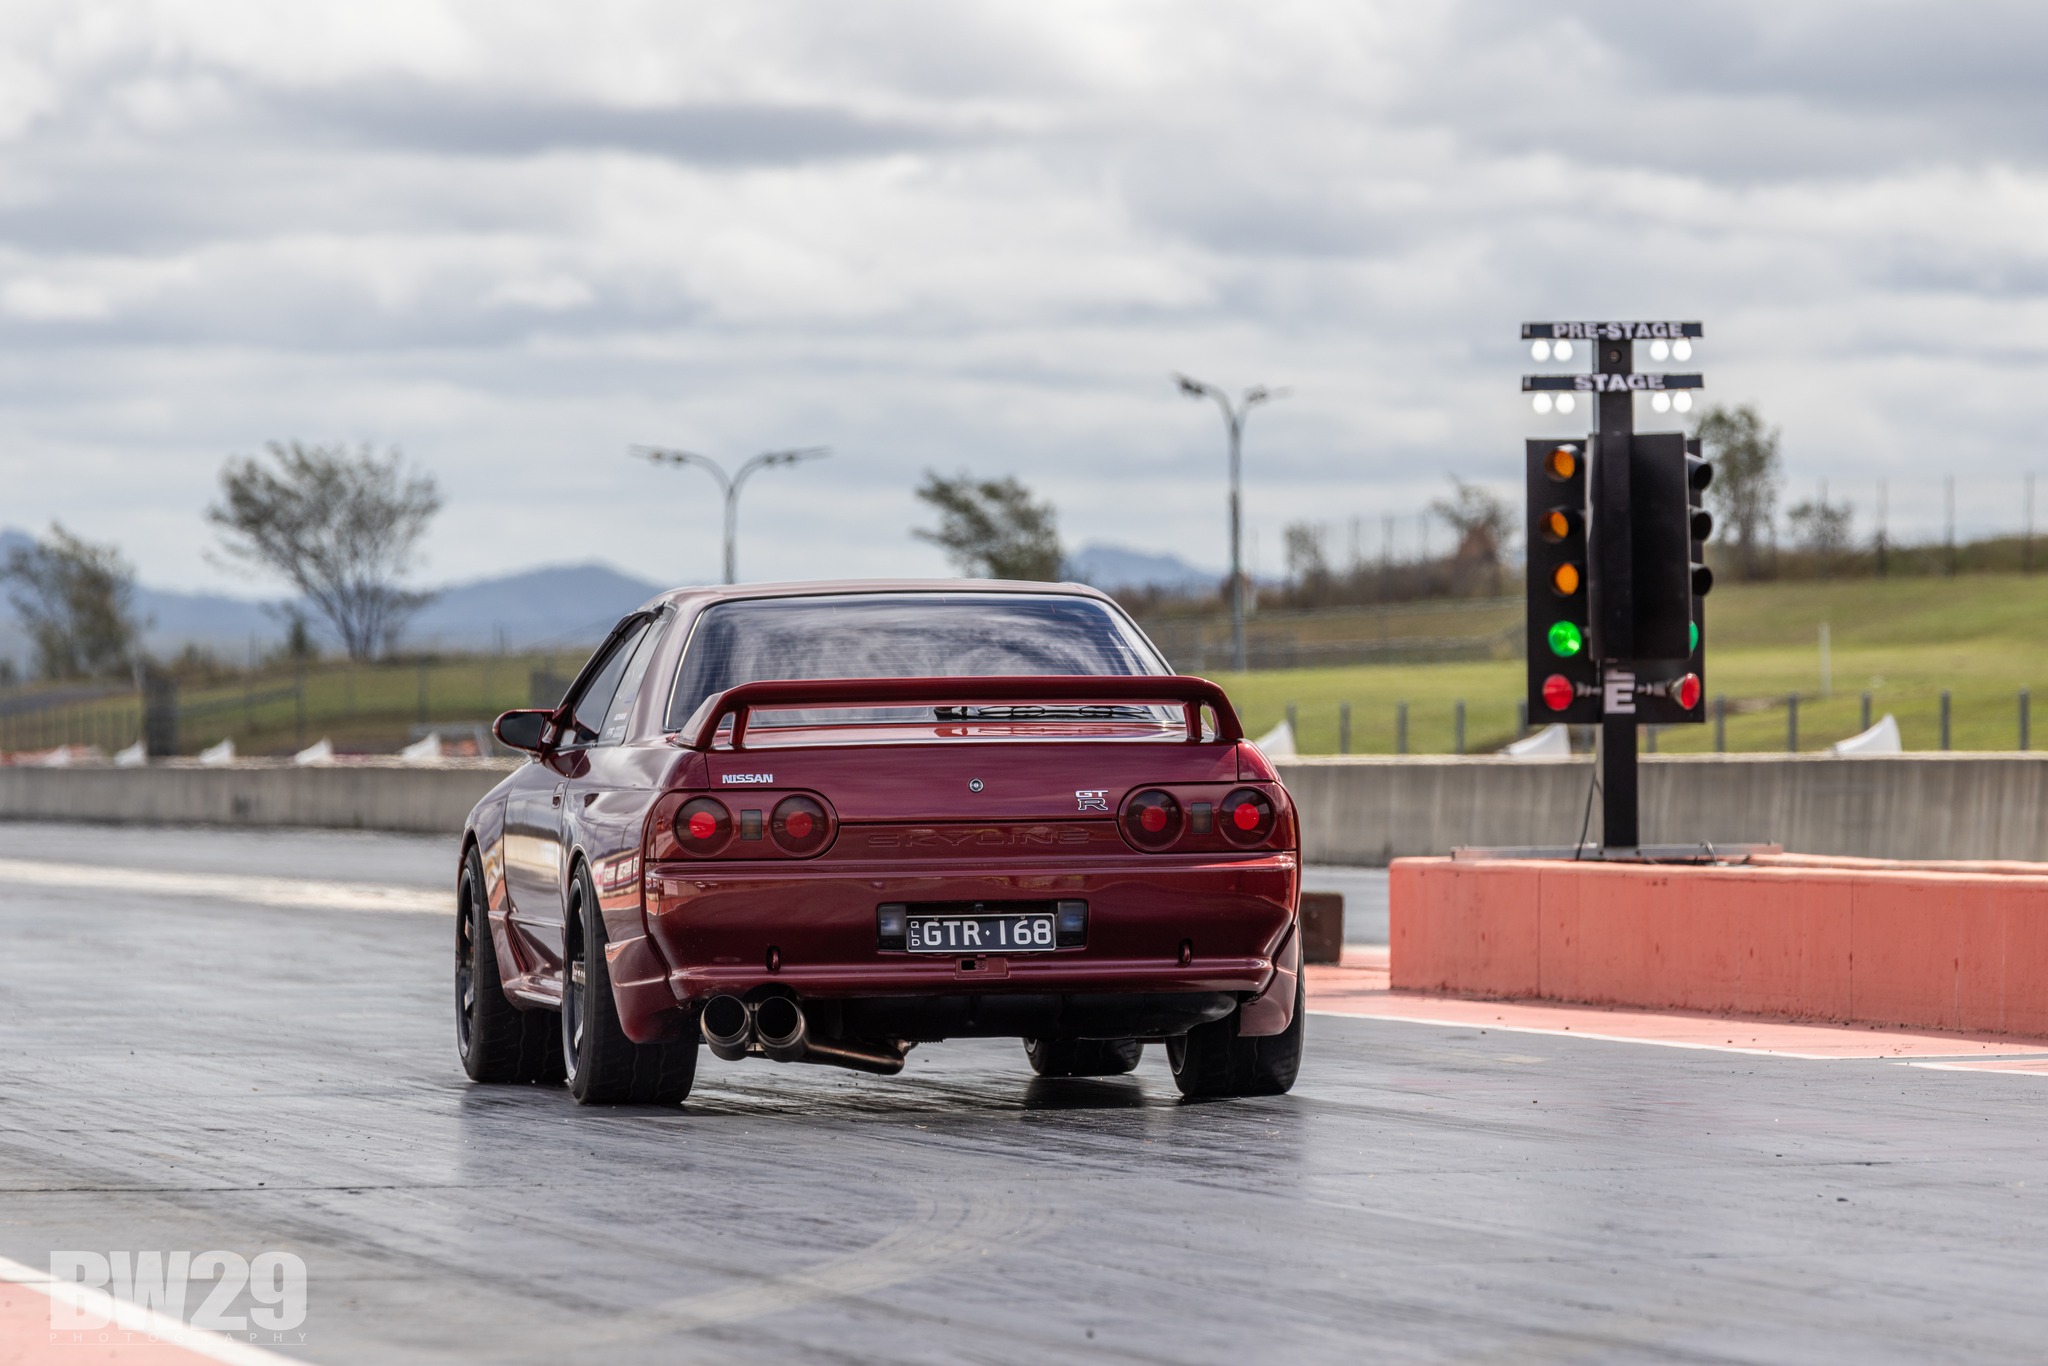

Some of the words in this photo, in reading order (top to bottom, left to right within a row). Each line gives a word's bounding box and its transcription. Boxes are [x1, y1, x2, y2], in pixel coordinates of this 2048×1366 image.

[1552, 322, 1684, 340] PRE-STAGE
[1574, 374, 1666, 392] STAGE
[722, 774, 773, 784] NISSAN
[1075, 790, 1109, 798] GT
[1077, 798, 1109, 811] R
[868, 831, 1090, 848] SKYLINE
[911, 921, 920, 946] QLD
